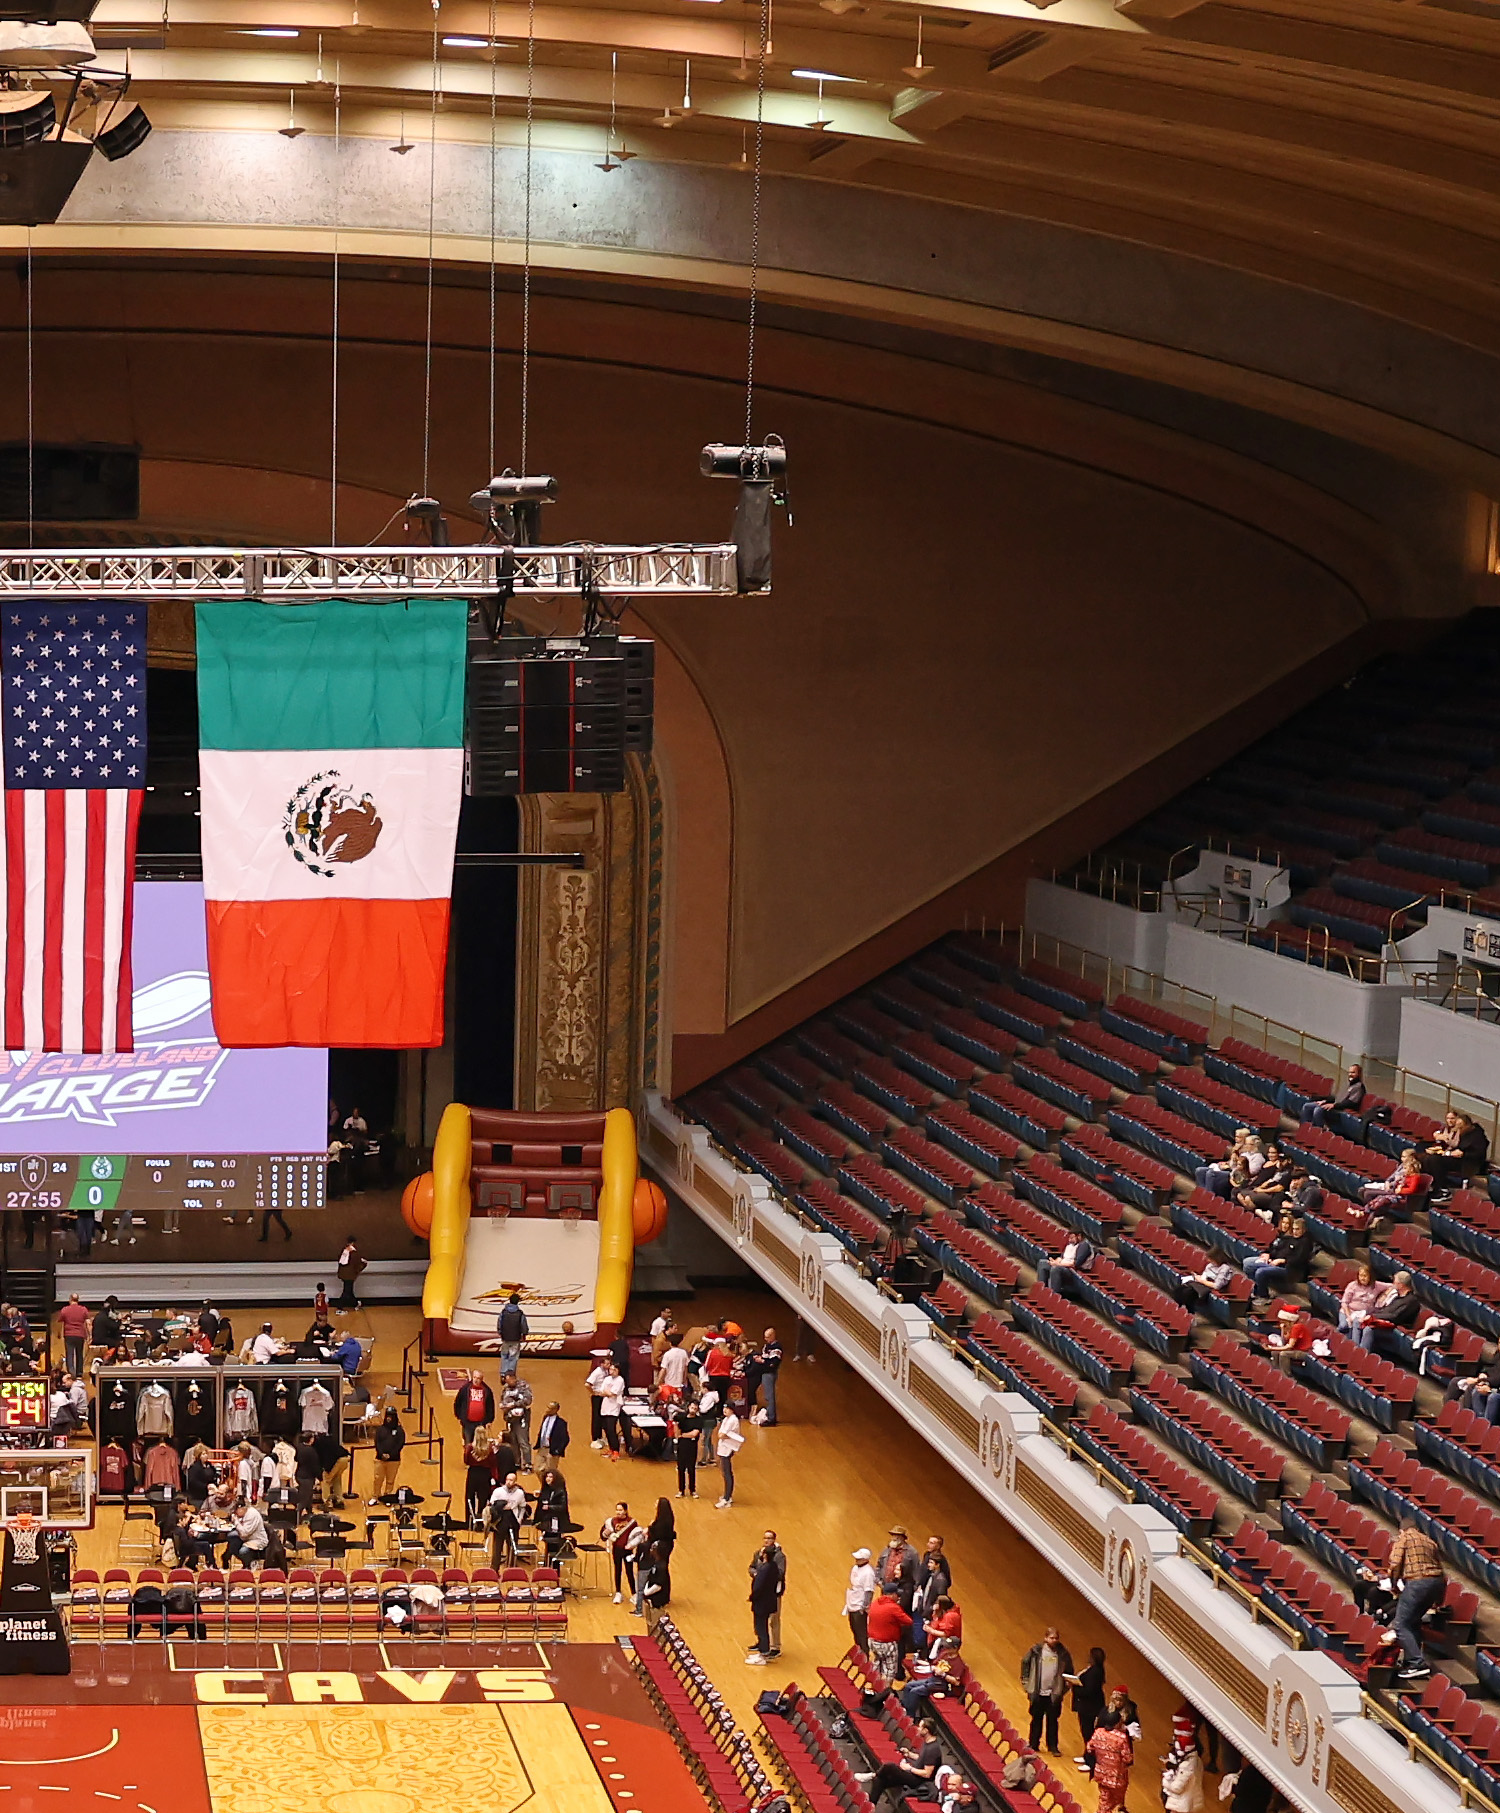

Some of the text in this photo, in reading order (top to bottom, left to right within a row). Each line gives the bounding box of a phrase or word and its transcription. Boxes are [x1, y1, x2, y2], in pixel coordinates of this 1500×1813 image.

[38, 1044, 219, 1076] CLEVELAND
[53, 1162, 67, 1172] 24
[145, 1159, 170, 1167] FOULS
[222, 1160, 236, 1168] 0.0
[30, 1172, 37, 1183] 0
[153, 1170, 162, 1183] 0
[221, 1180, 235, 1188] 0.0
[7, 1192, 61, 1208] 27:55
[89, 1186, 102, 1205] 0
[183, 1200, 223, 1208] TOL 5
[1, 1383, 45, 1398] 27:54
[6, 1399, 41, 1425] 24
[0, 1618, 47, 1632] planet
[6, 1628, 57, 1641] fitness
[193, 1670, 555, 1704] CAVS
